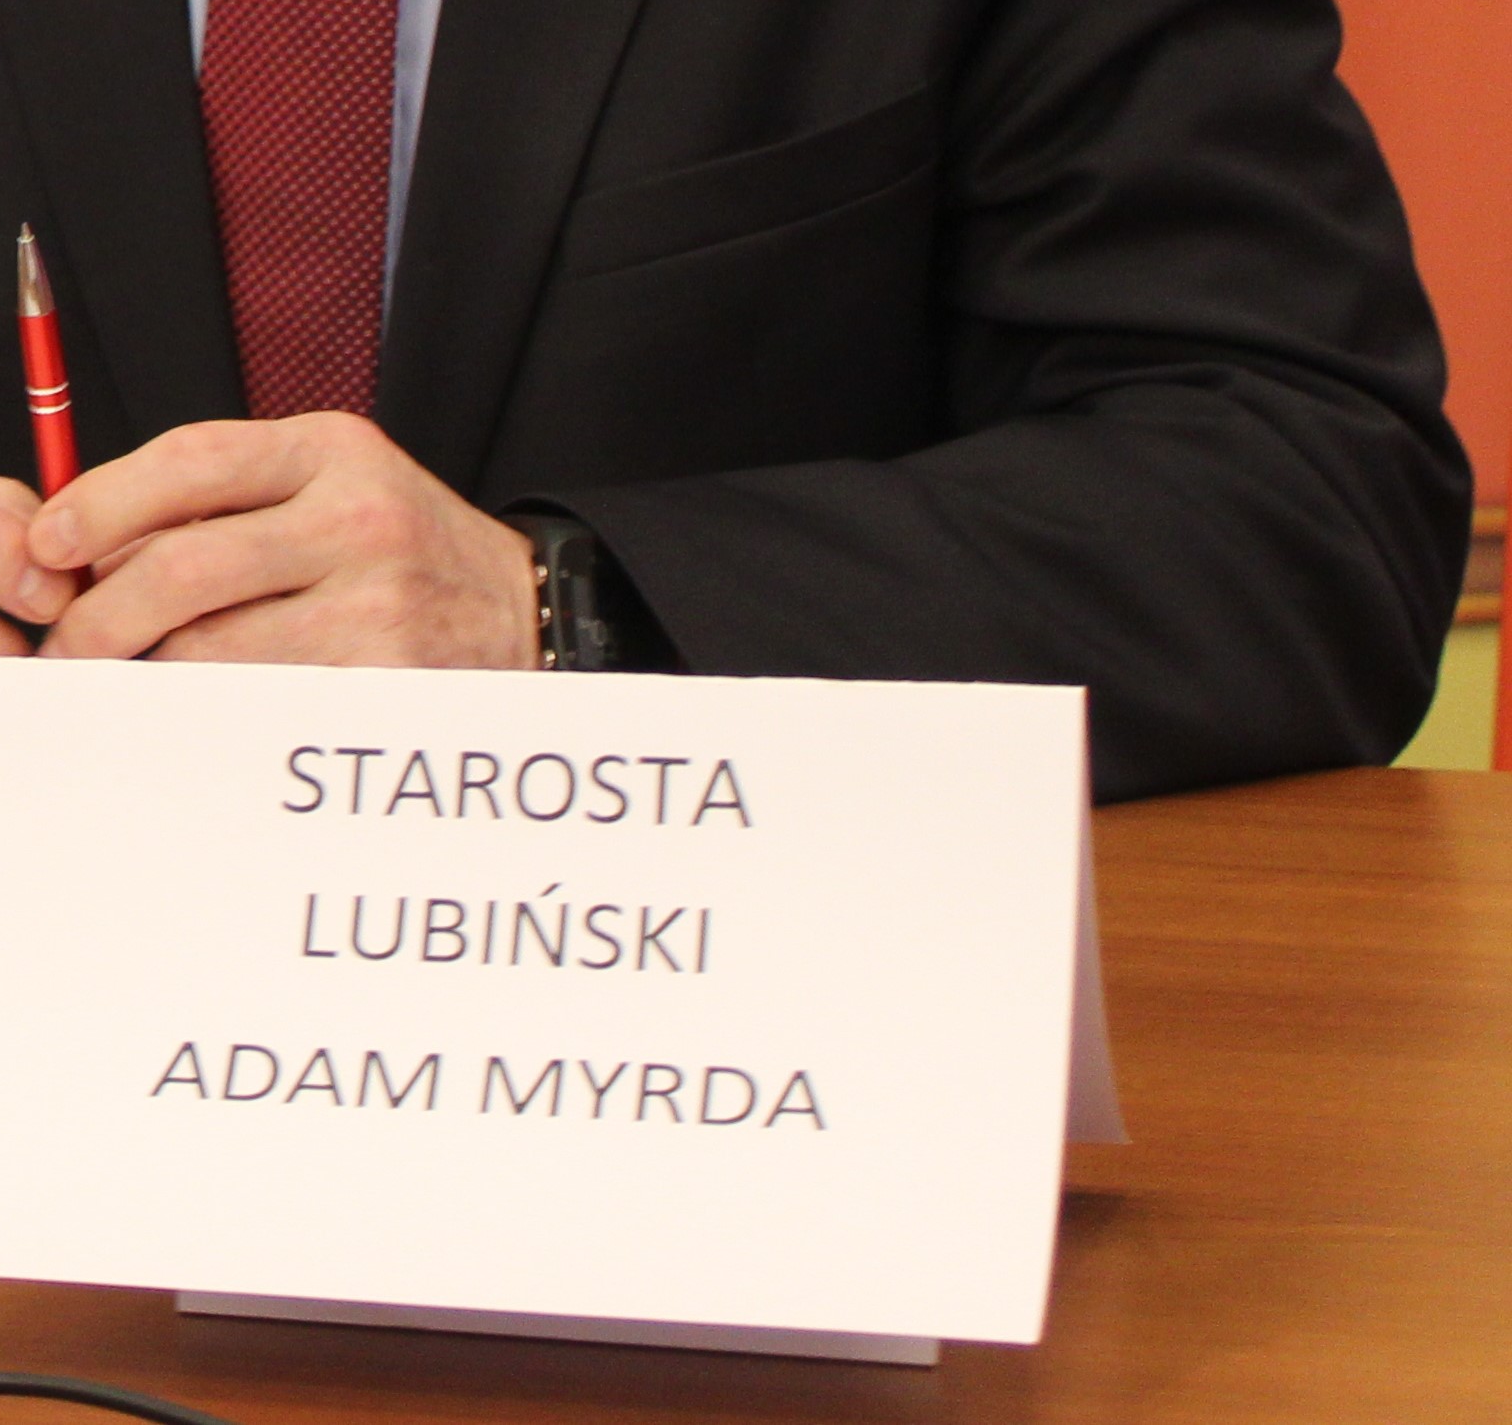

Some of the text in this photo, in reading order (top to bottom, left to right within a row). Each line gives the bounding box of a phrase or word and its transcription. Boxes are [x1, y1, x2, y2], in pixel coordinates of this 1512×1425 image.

[281, 745, 754, 829] STAROSTA
[301, 882, 713, 974] LUBIŃSKI
[149, 1041, 829, 1132] ADAM MYRDA
